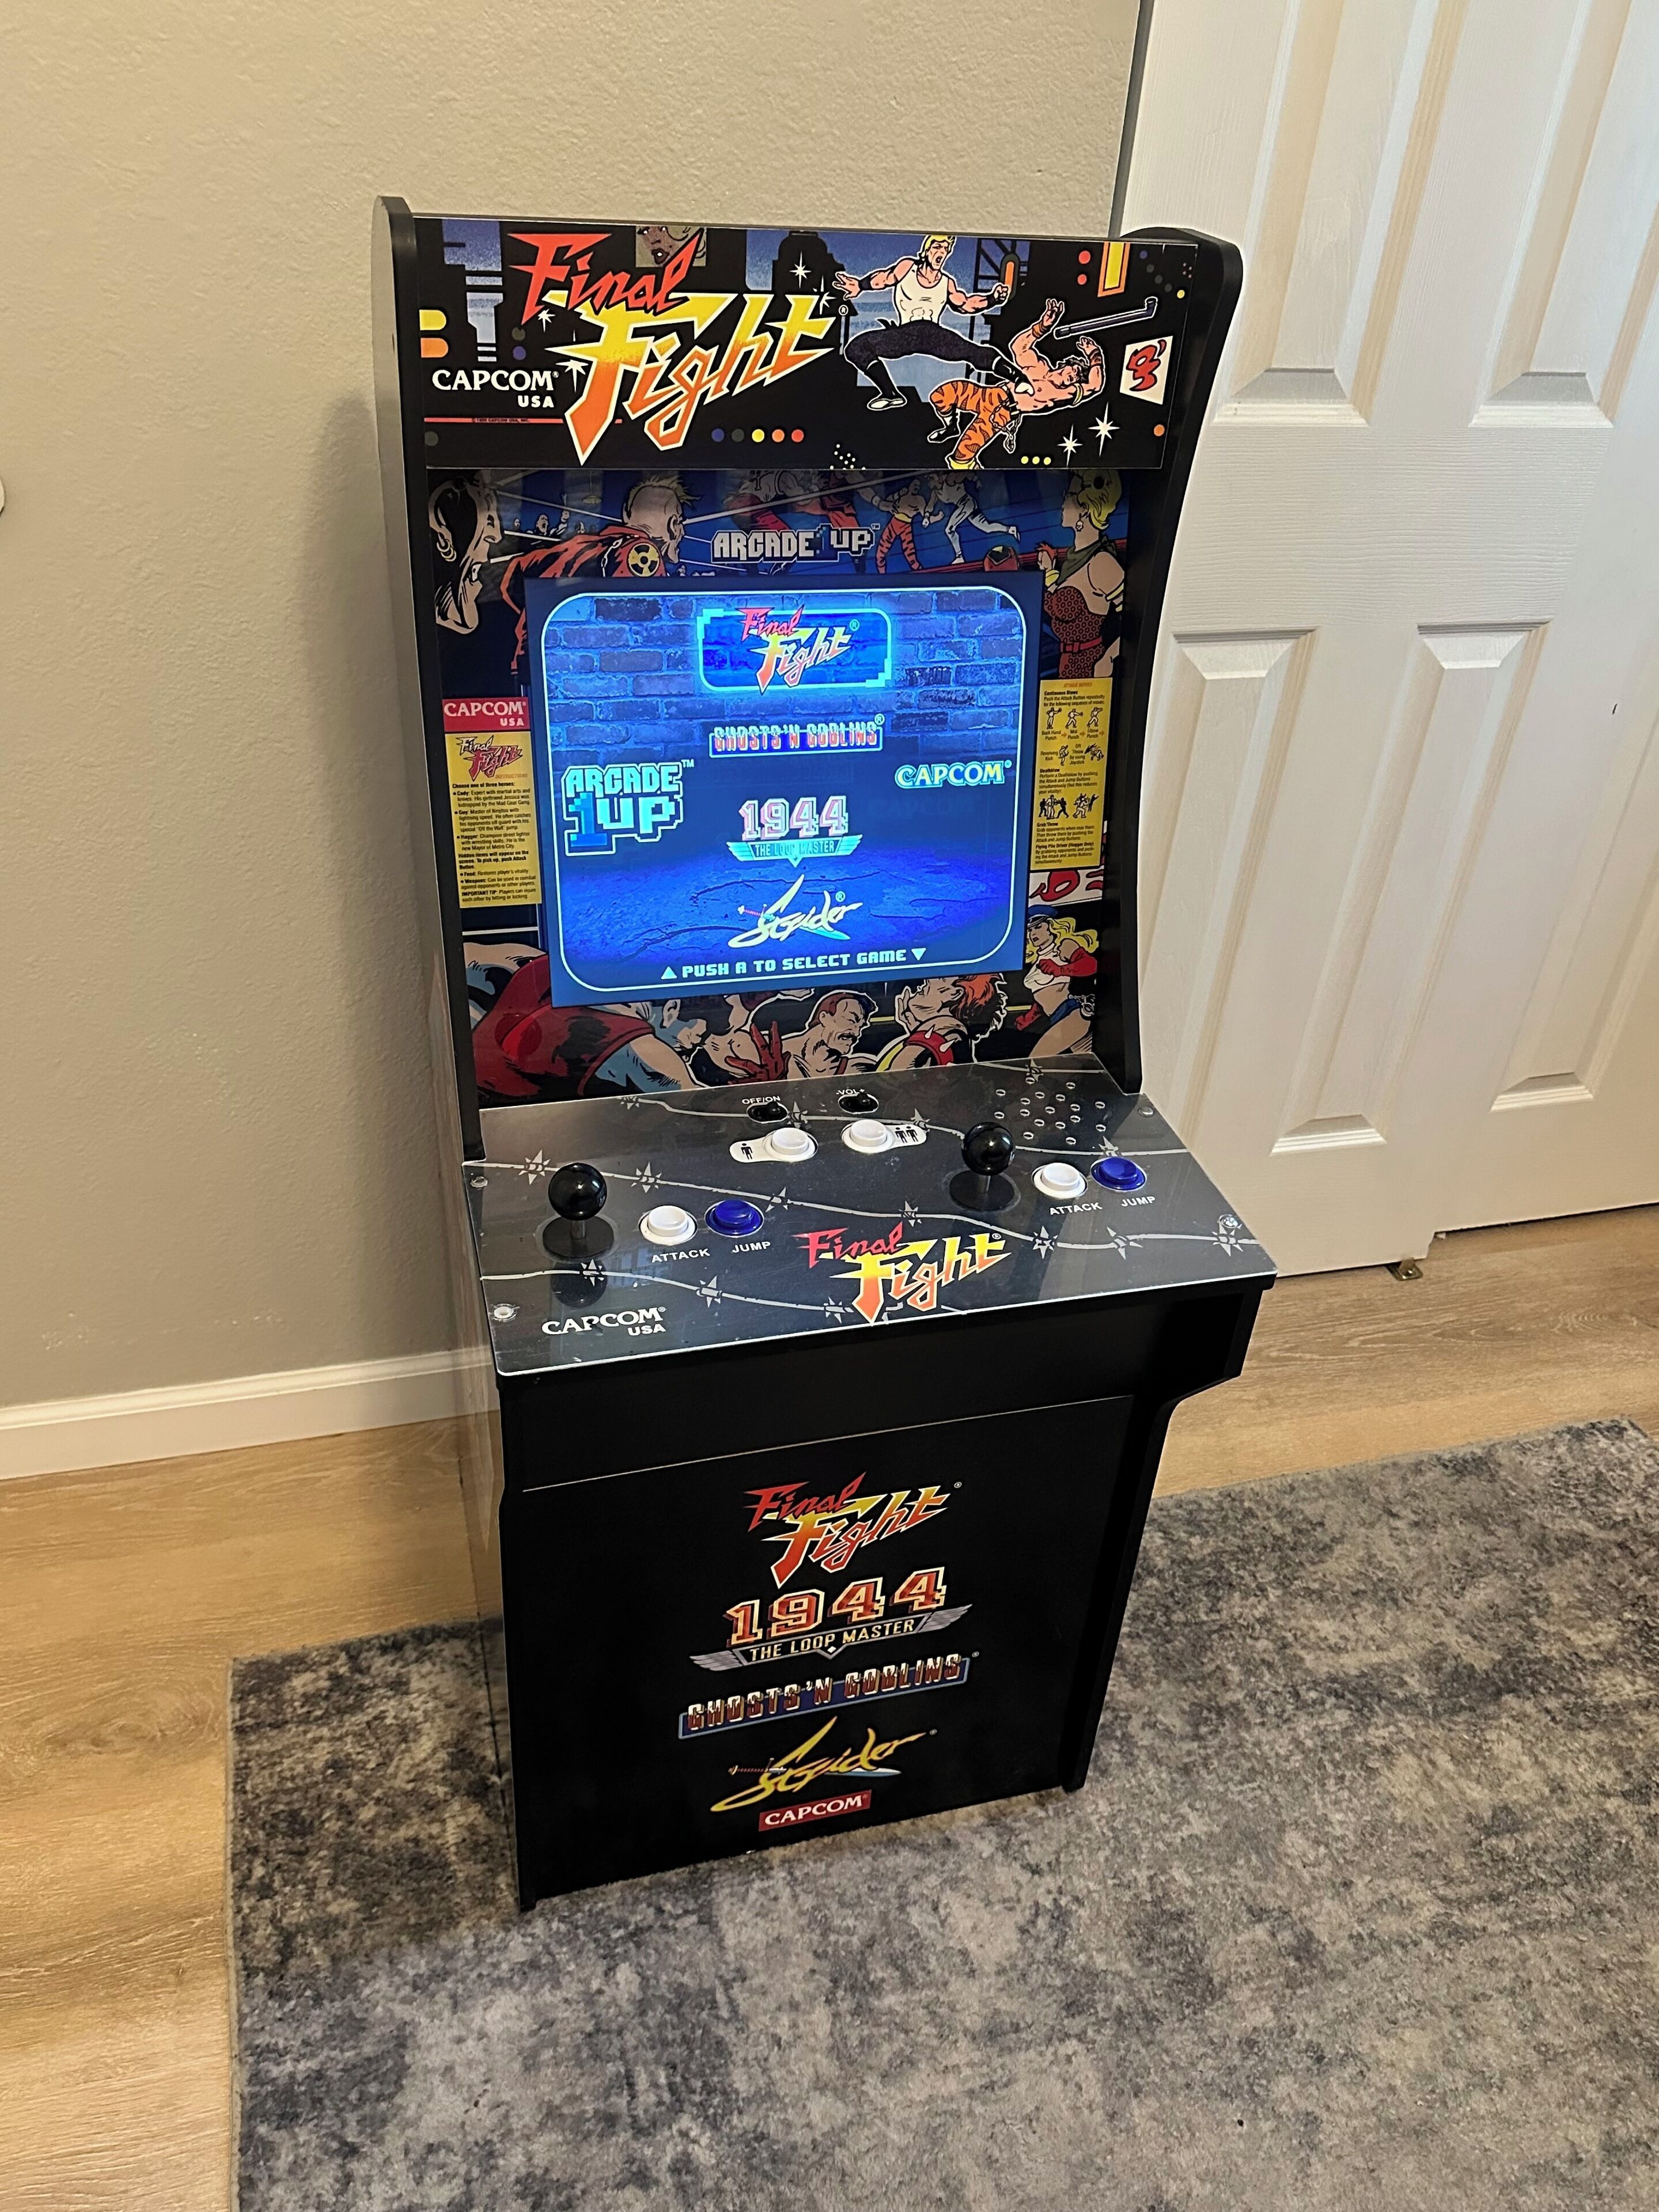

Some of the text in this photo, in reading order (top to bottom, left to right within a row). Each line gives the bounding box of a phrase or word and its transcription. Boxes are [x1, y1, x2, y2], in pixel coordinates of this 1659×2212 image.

[506, 228, 702, 325] Final
[432, 369, 554, 391] CAPCOM
[544, 290, 837, 466] Fight
[517, 395, 554, 408] USA
[714, 532, 814, 560] ARCADE
[736, 604, 805, 641] Final
[750, 627, 851, 695] Fight
[444, 702, 524, 717] CAPCOM
[500, 718, 524, 726] USA
[456, 735, 494, 756] Final
[806, 721, 877, 748] GOBLINS
[463, 745, 522, 782] Fight
[896, 762, 1004, 787] CAPCOM
[565, 764, 680, 798] ARCADE
[569, 792, 675, 847] 1UP
[738, 796, 849, 840] 1944
[755, 844, 770, 857] THE
[798, 840, 835, 855] MASTER
[728, 874, 863, 948] Strider
[682, 949, 907, 978] PUSH A TO SELECT GAME
[742, 1096, 781, 1104] OFF/ON
[1050, 1202, 1103, 1215] ATTACK
[1120, 1195, 1156, 1207] JUMP
[652, 1248, 710, 1263] ATTACK
[732, 1241, 771, 1253] JUMP
[792, 1221, 911, 1268] Final
[830, 1233, 1012, 1325] Fight
[542, 1307, 663, 1335] CAPCOM
[628, 1324, 666, 1336] USA
[743, 1472, 866, 1532] Final
[762, 1486, 950, 1589] Fight
[724, 1566, 947, 1647] 1944
[750, 1618, 915, 1661] THE LOOP MASTER
[843, 1653, 968, 1699] GOBLINS
[710, 1715, 927, 1812] Strider
[764, 1794, 862, 1826] CAPCOM
